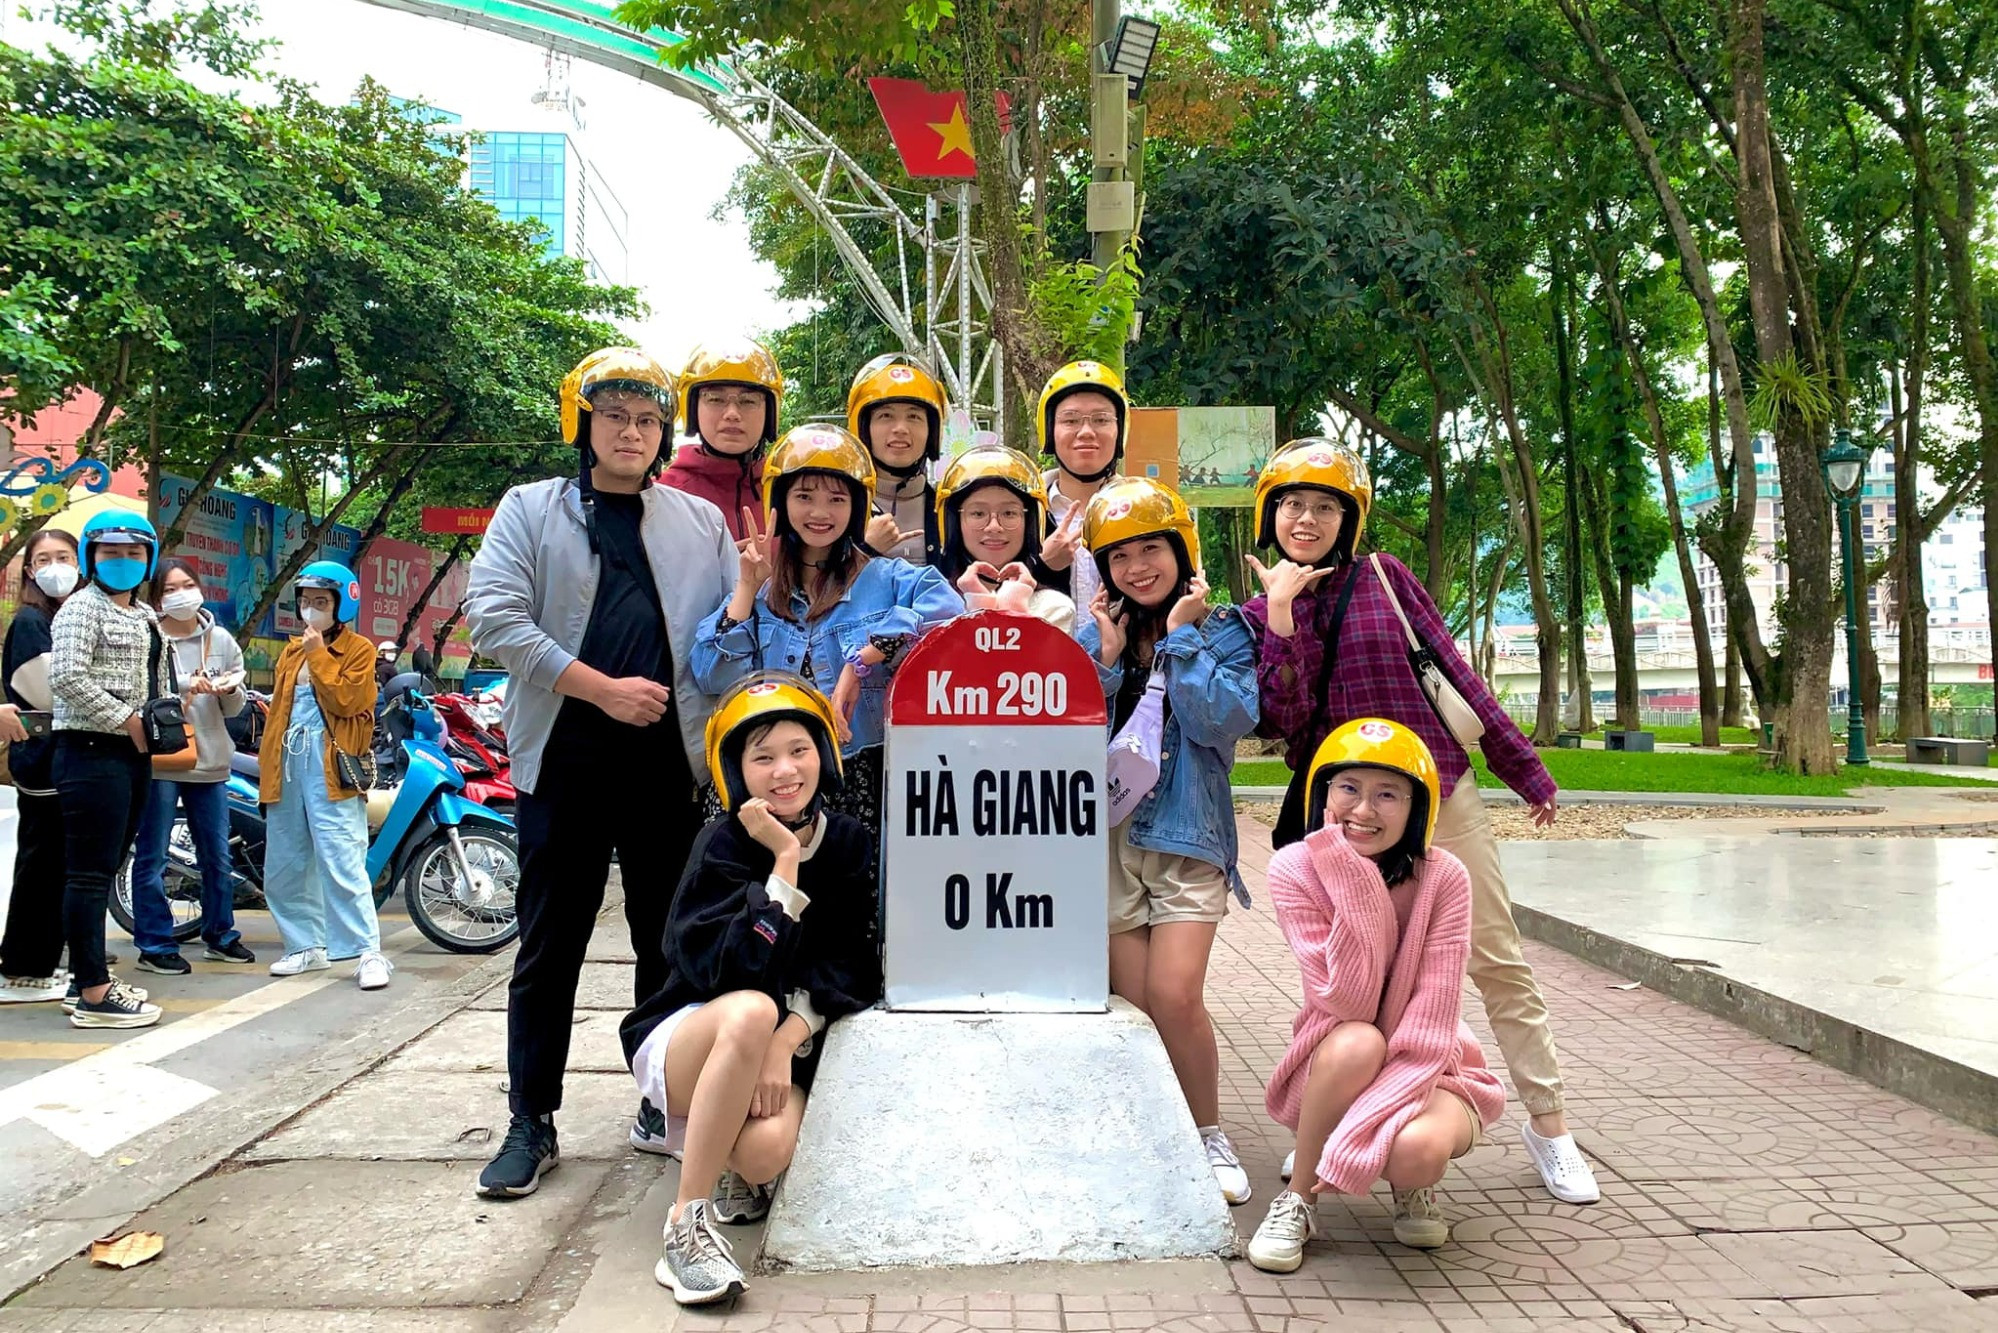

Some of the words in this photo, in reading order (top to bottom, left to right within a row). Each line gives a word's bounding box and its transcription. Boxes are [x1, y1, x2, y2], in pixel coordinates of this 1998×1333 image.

[890, 369, 910, 379] GS
[812, 435, 836, 448] GS
[1308, 453, 1332, 465] GS
[975, 628, 1021, 652] QL2
[927, 670, 989, 715] Km
[996, 671, 1067, 716] 290
[1361, 724, 1391, 737] GS
[905, 755, 959, 837] HÀ
[973, 769, 1097, 837] GIANG
[986, 873, 1054, 929] Km
